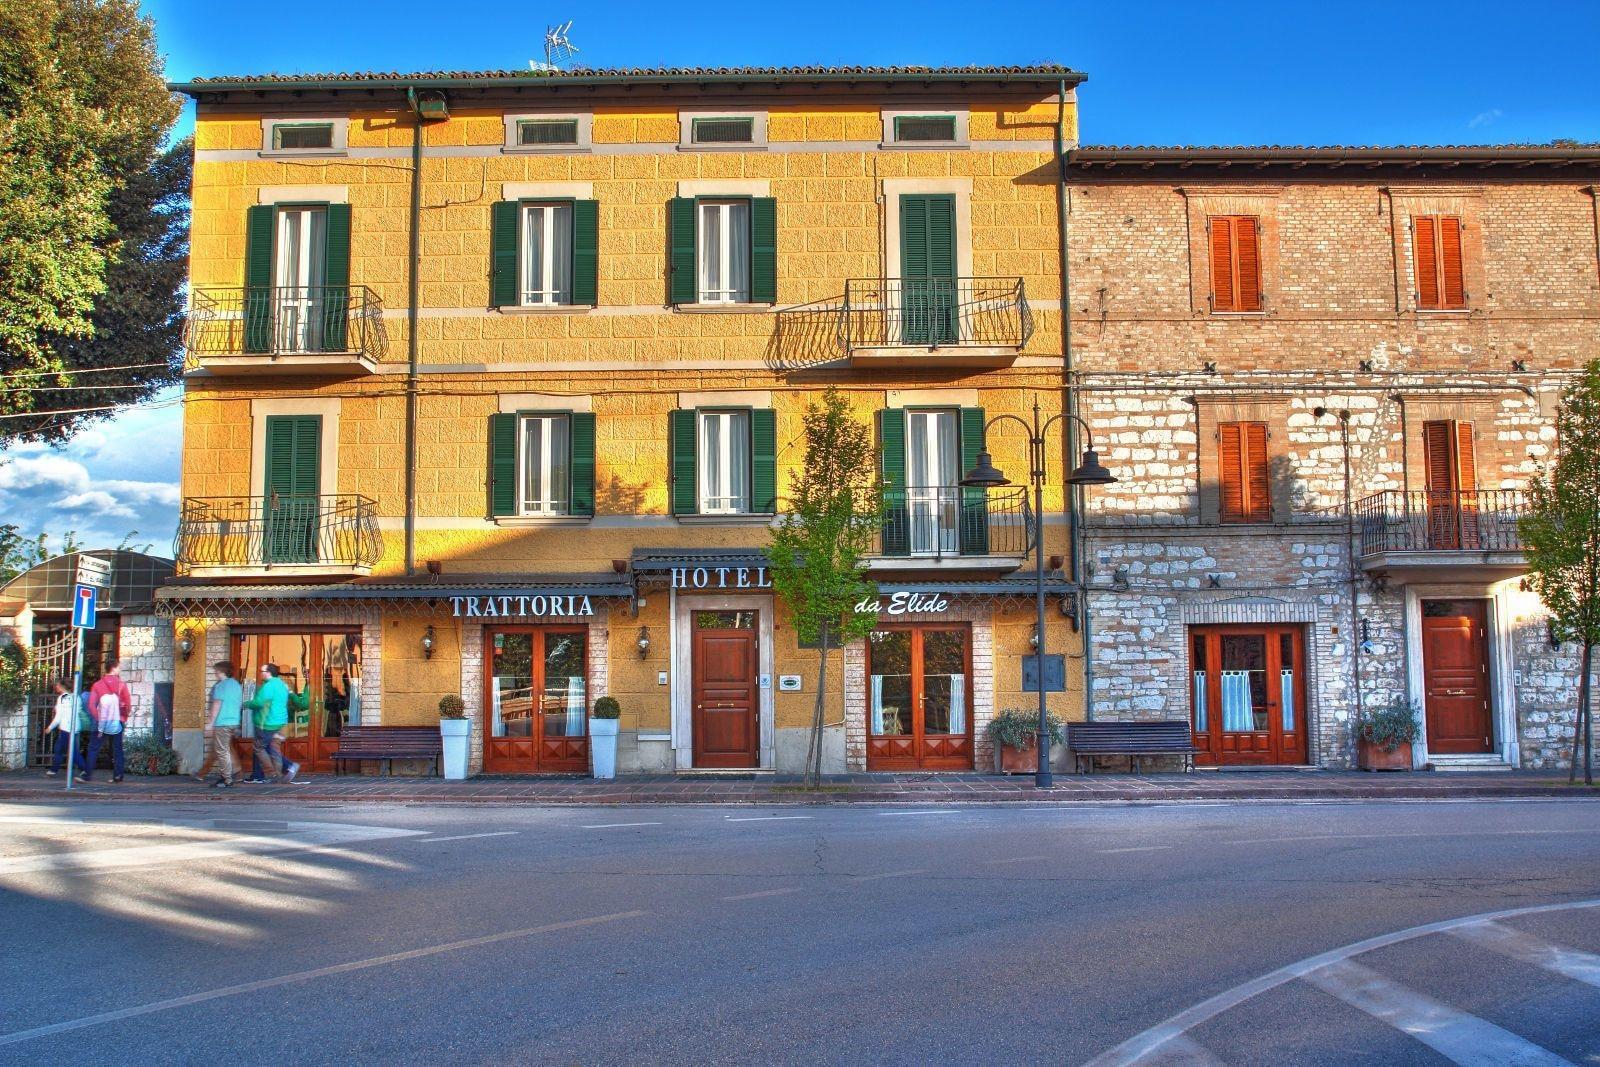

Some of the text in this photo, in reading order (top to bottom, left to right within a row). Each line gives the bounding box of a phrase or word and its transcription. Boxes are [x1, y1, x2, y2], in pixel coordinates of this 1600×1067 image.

[671, 567, 772, 588] HOTEL
[449, 595, 594, 617] TRATTORIA
[854, 591, 948, 615] da Elide
